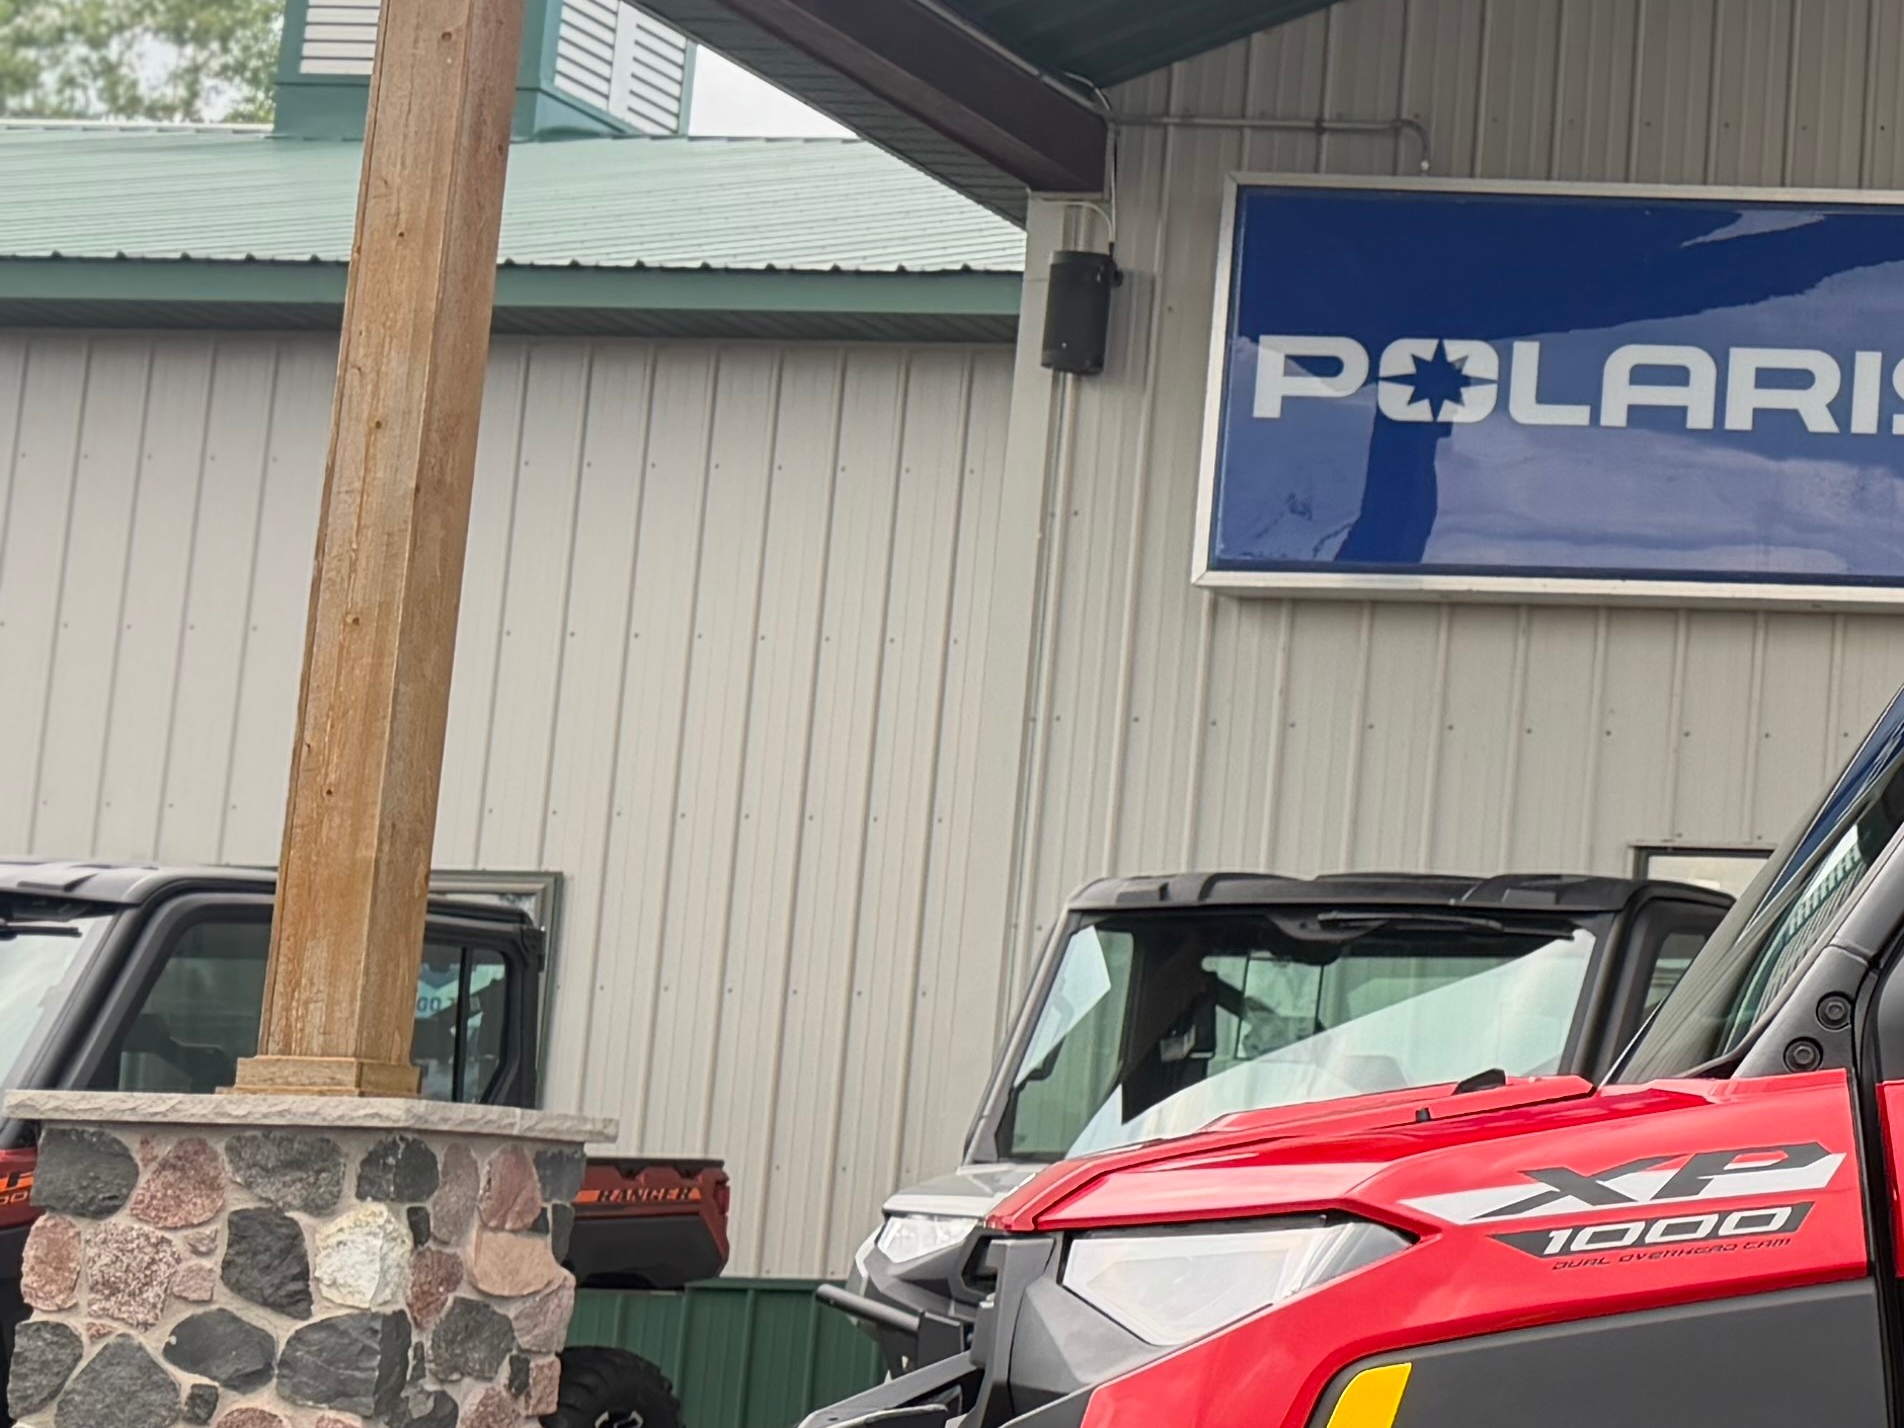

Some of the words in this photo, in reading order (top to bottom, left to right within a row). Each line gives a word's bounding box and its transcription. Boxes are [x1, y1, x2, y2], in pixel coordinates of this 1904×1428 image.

[597, 1187, 697, 1203] RANGER
[1472, 1140, 1832, 1221] XP
[1541, 1205, 1795, 1255] 1000
[1551, 1256, 1612, 1271] DUAL
[1618, 1242, 1738, 1264] OVERHEAD
[1742, 1237, 1792, 1251] CAM
